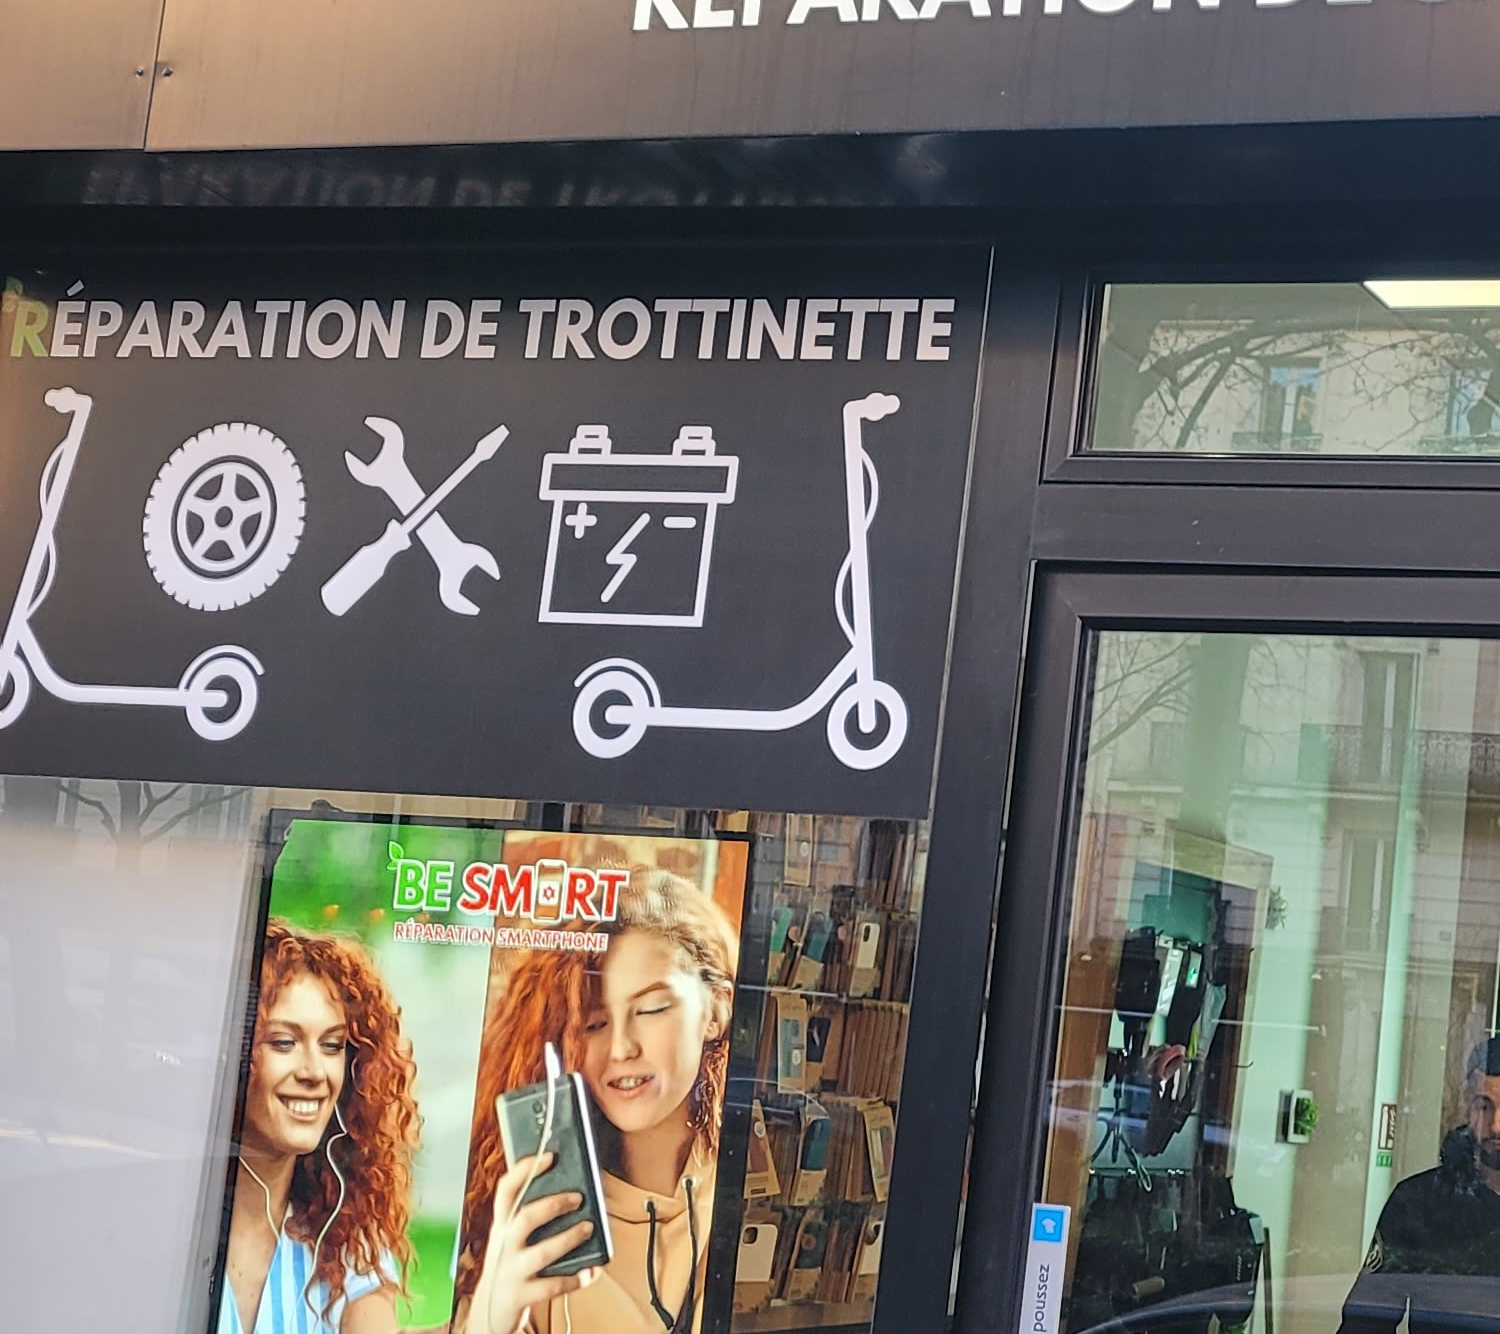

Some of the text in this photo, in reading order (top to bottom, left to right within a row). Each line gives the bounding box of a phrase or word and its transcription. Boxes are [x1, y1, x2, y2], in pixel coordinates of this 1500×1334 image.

[9, 280, 956, 362] RÉPARATION DE TROTTINETTE
[391, 857, 455, 912] BE
[393, 917, 609, 952] RÉPARATION SMARTPHONE
[1033, 1264, 1050, 1333] poussez
